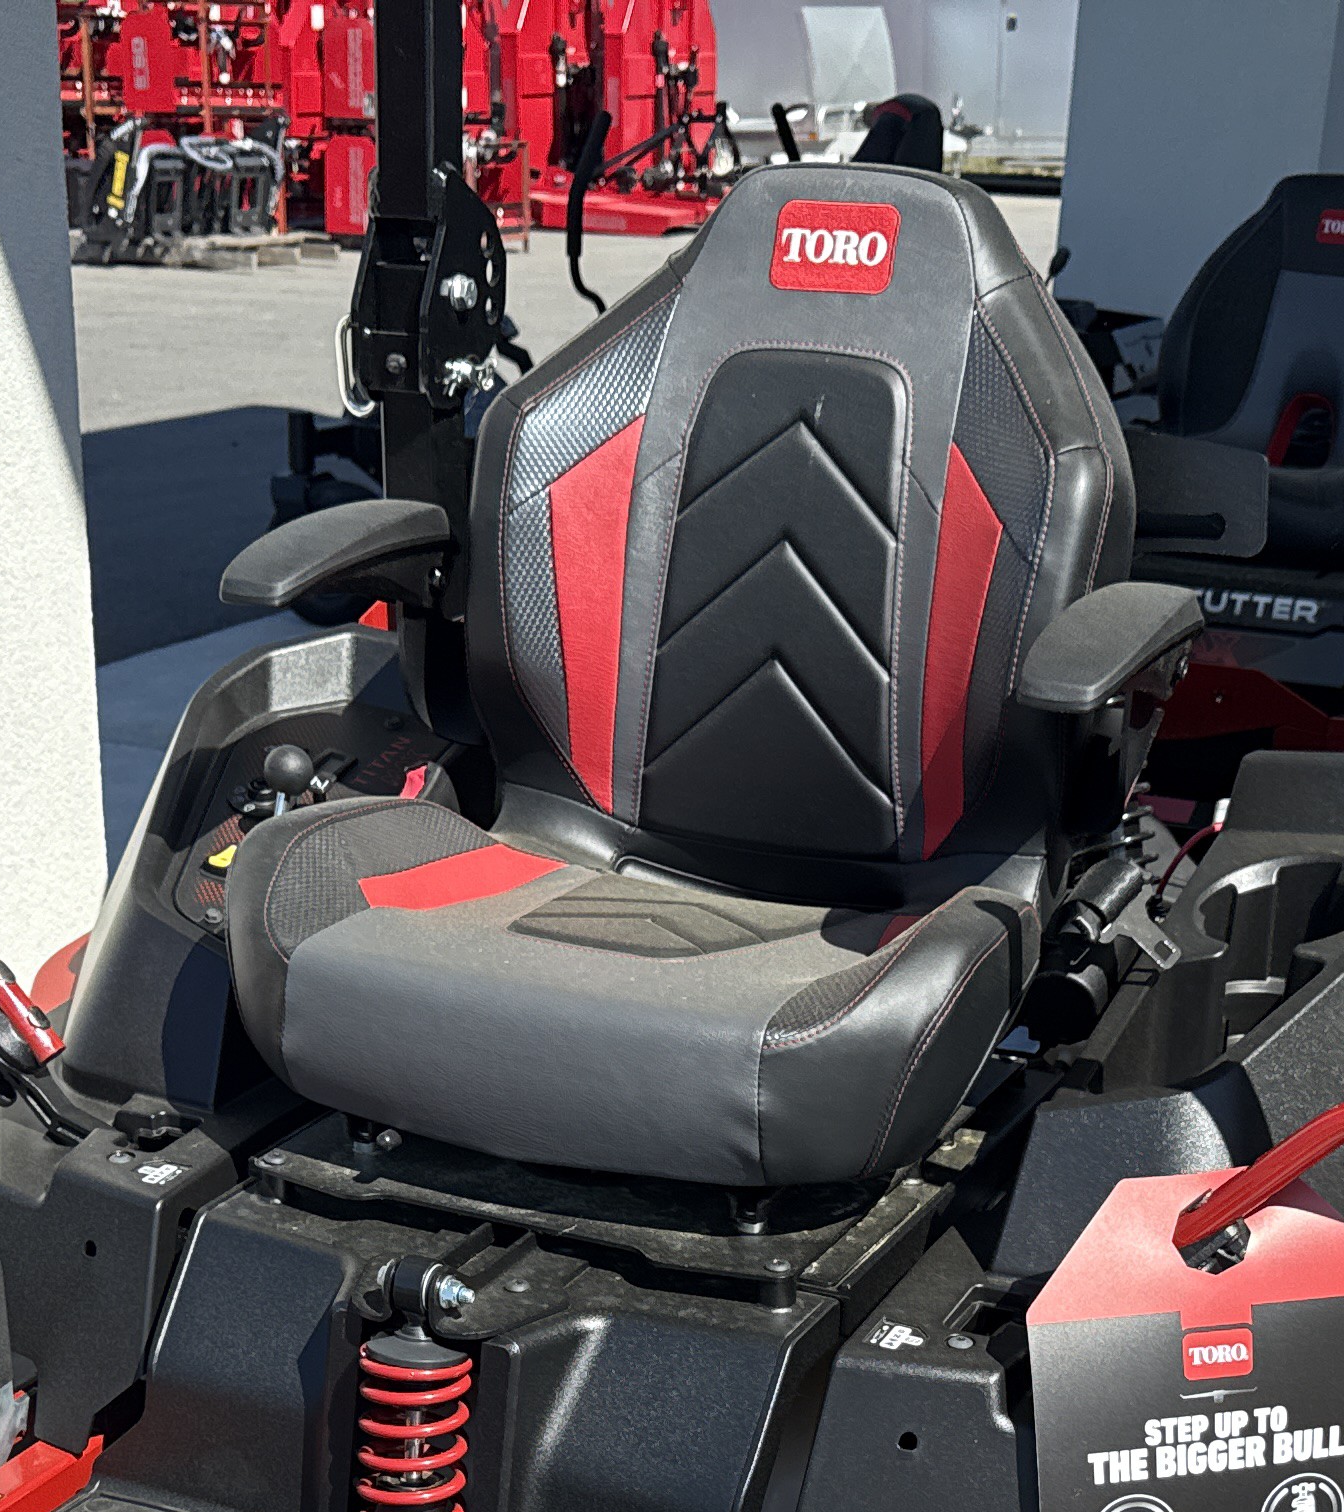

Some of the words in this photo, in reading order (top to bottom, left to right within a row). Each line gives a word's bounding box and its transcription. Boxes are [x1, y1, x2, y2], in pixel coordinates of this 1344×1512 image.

[781, 227, 888, 266] TORO
[1196, 588, 1319, 624] UTTER
[1188, 1342, 1250, 1366] TORO
[1144, 1414, 1209, 1446] STEP
[1214, 1410, 1249, 1439] UP
[1253, 1405, 1288, 1434] TO
[1087, 1447, 1149, 1485] THE
[1155, 1435, 1266, 1479] BIGGER
